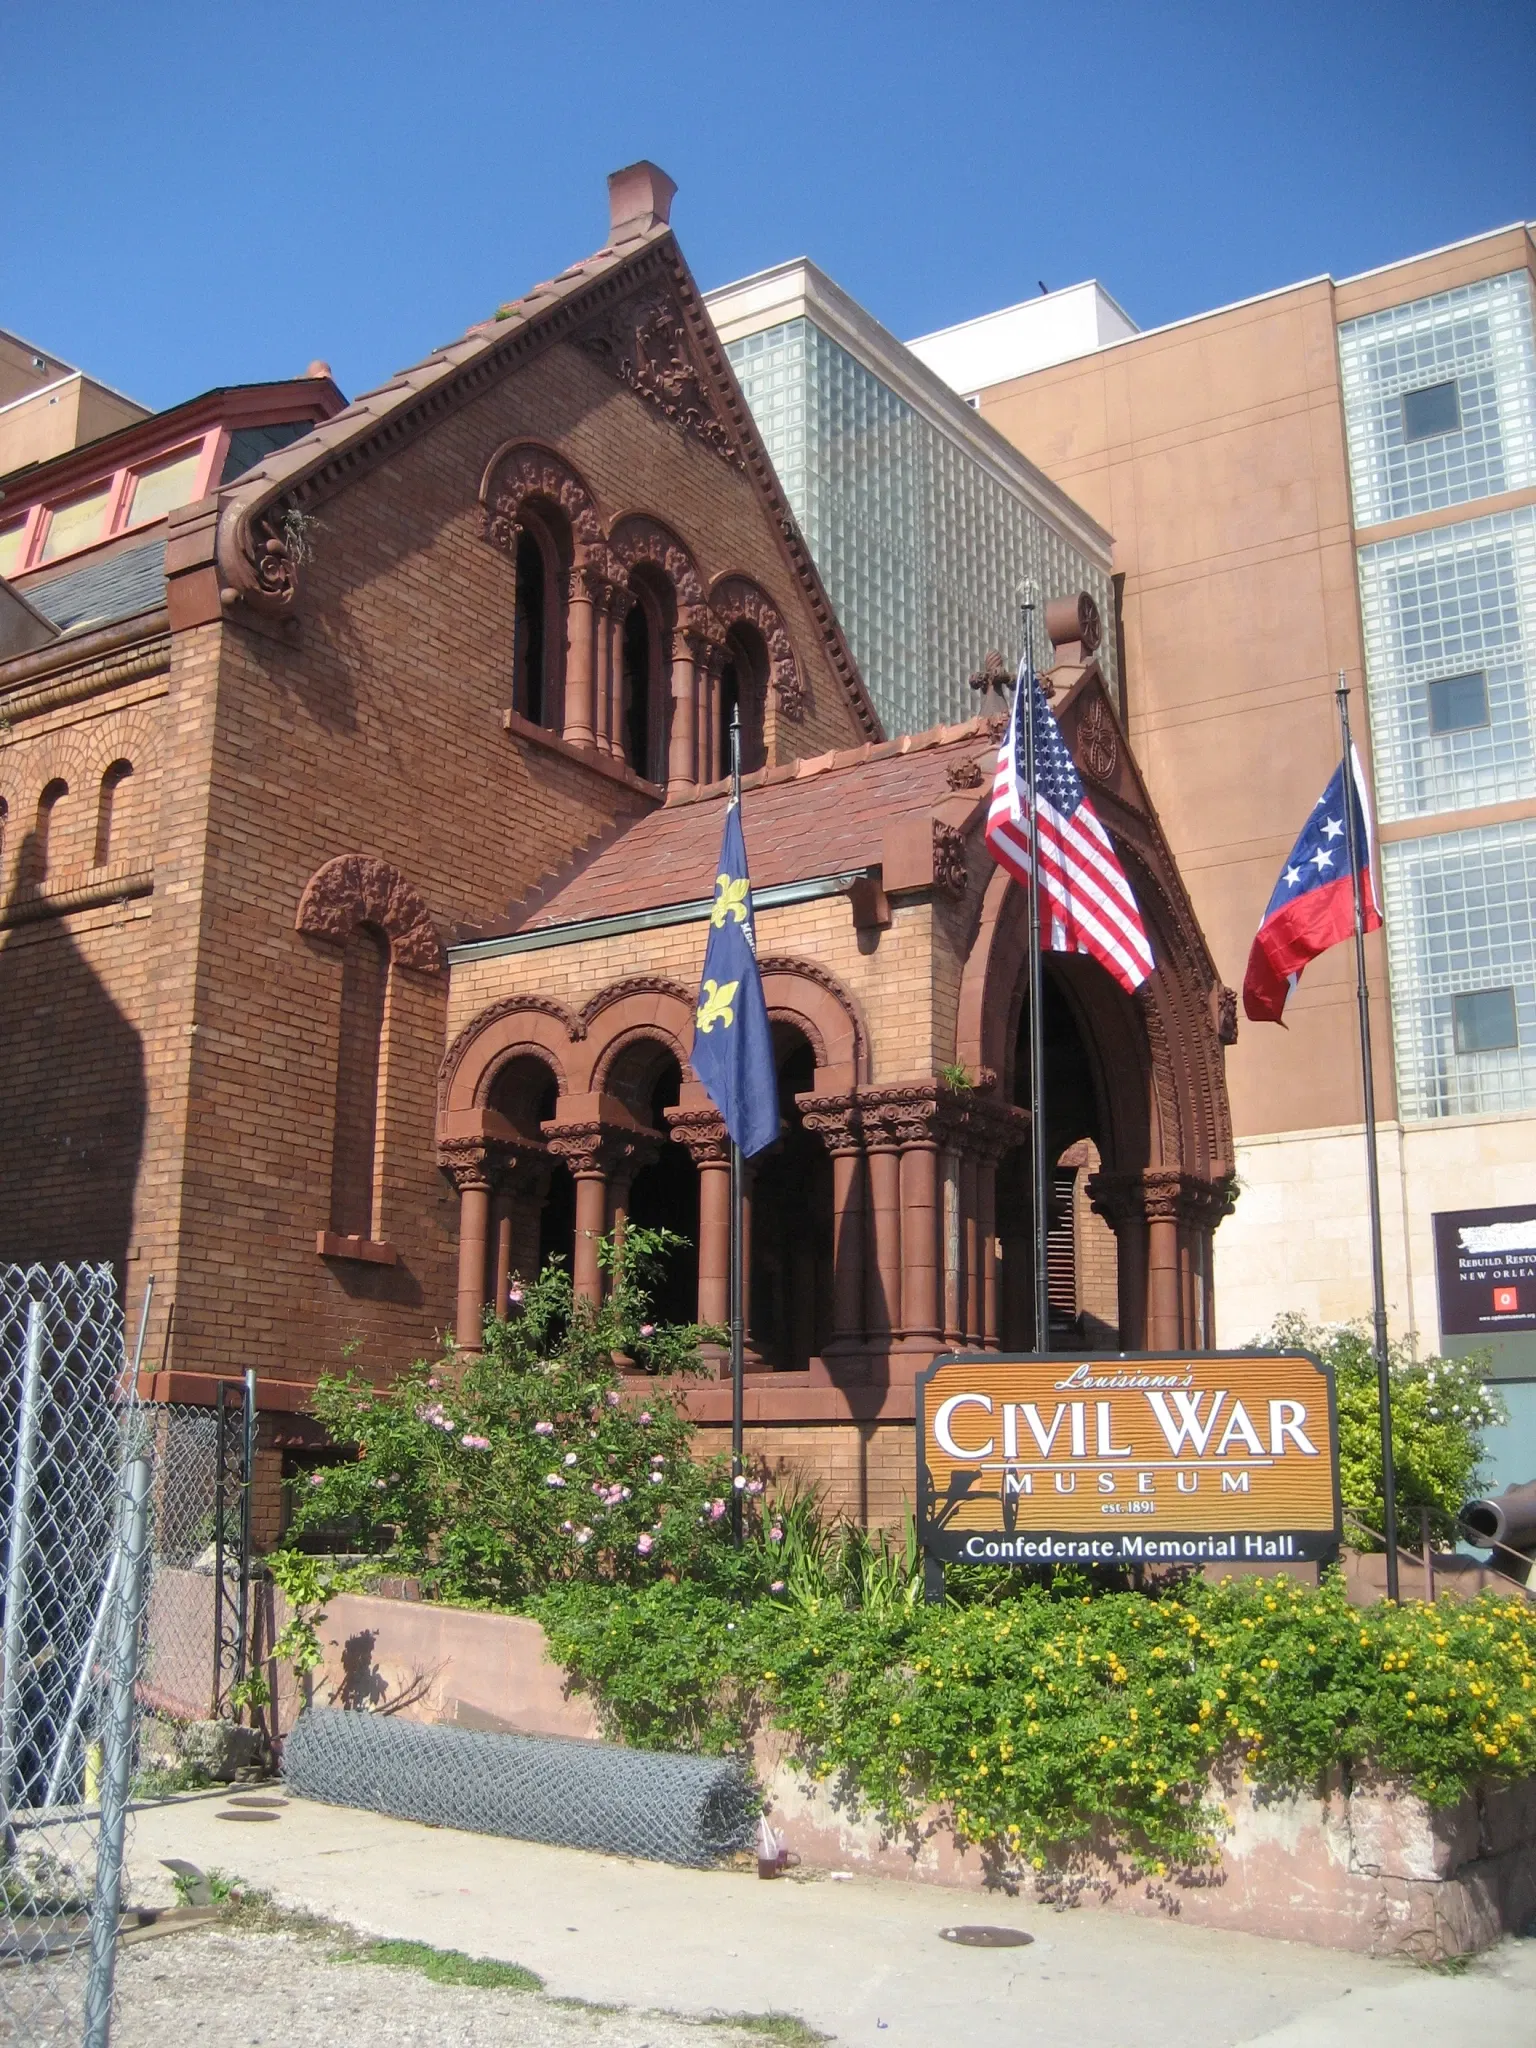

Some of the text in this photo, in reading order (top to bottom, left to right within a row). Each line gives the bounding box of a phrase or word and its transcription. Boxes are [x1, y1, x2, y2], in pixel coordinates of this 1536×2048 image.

[1460, 1271, 1486, 1281] NEW
[1054, 1363, 1194, 1390] Louisiana's
[933, 1390, 1320, 1459] CIVIL WAR
[1005, 1471, 1251, 1494] MUSEUM
[1101, 1500, 1154, 1513] est. 1891
[966, 1535, 1293, 1557] Confederate Memorial Hall
